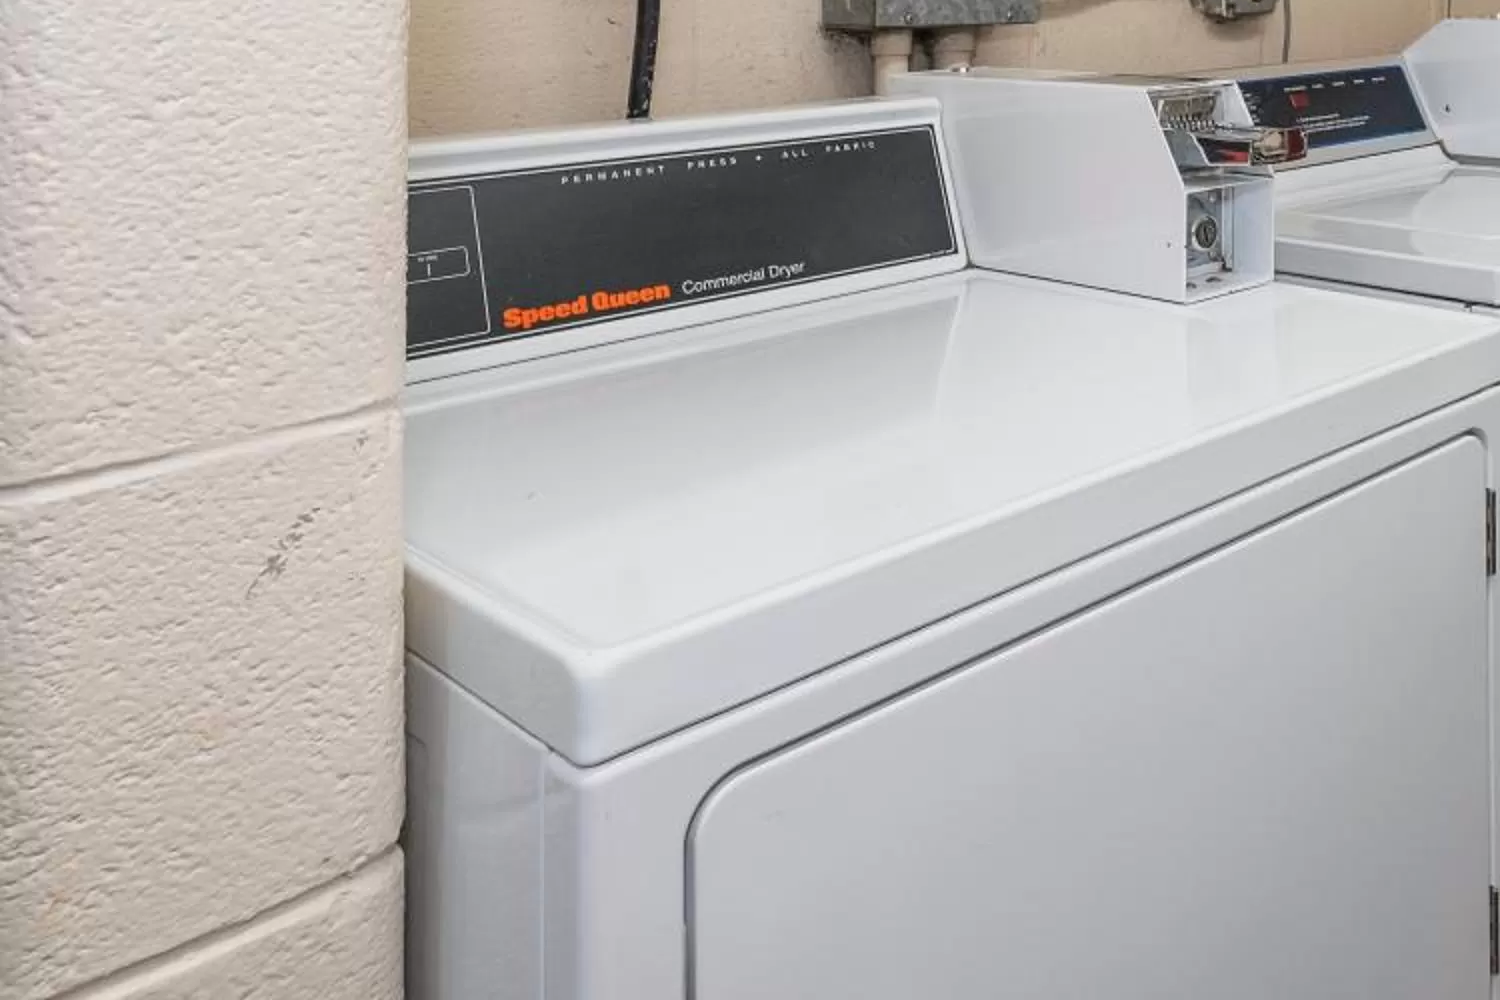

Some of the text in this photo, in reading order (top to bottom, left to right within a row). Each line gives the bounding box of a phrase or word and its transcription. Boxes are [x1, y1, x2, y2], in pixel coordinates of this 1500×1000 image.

[561, 164, 666, 185] PERMANENT
[687, 156, 738, 171] PRESS
[781, 148, 809, 160] ALL
[502, 260, 806, 330] Speed Queen Commercial Dryer
